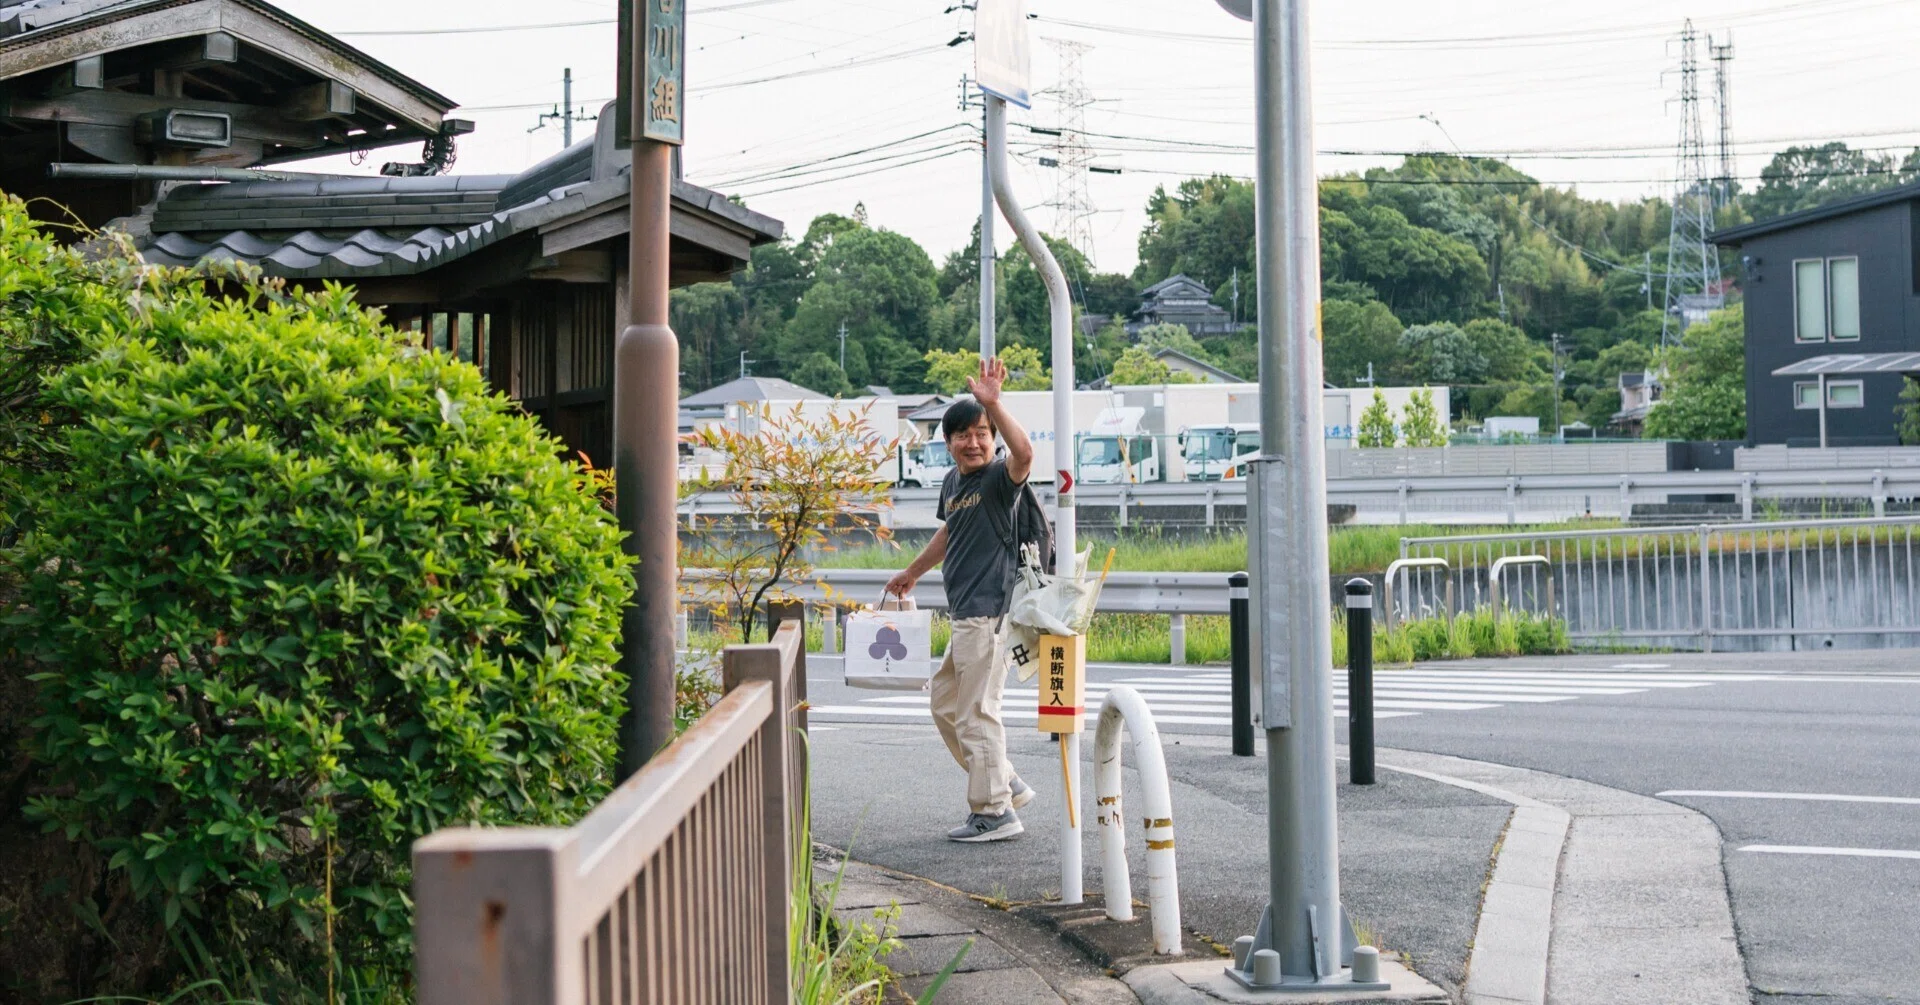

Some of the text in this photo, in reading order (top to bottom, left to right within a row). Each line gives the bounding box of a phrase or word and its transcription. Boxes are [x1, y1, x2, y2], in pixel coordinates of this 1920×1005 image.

[1050, 646, 1064, 706] 横断旗入
[975, 822, 988, 832] N
